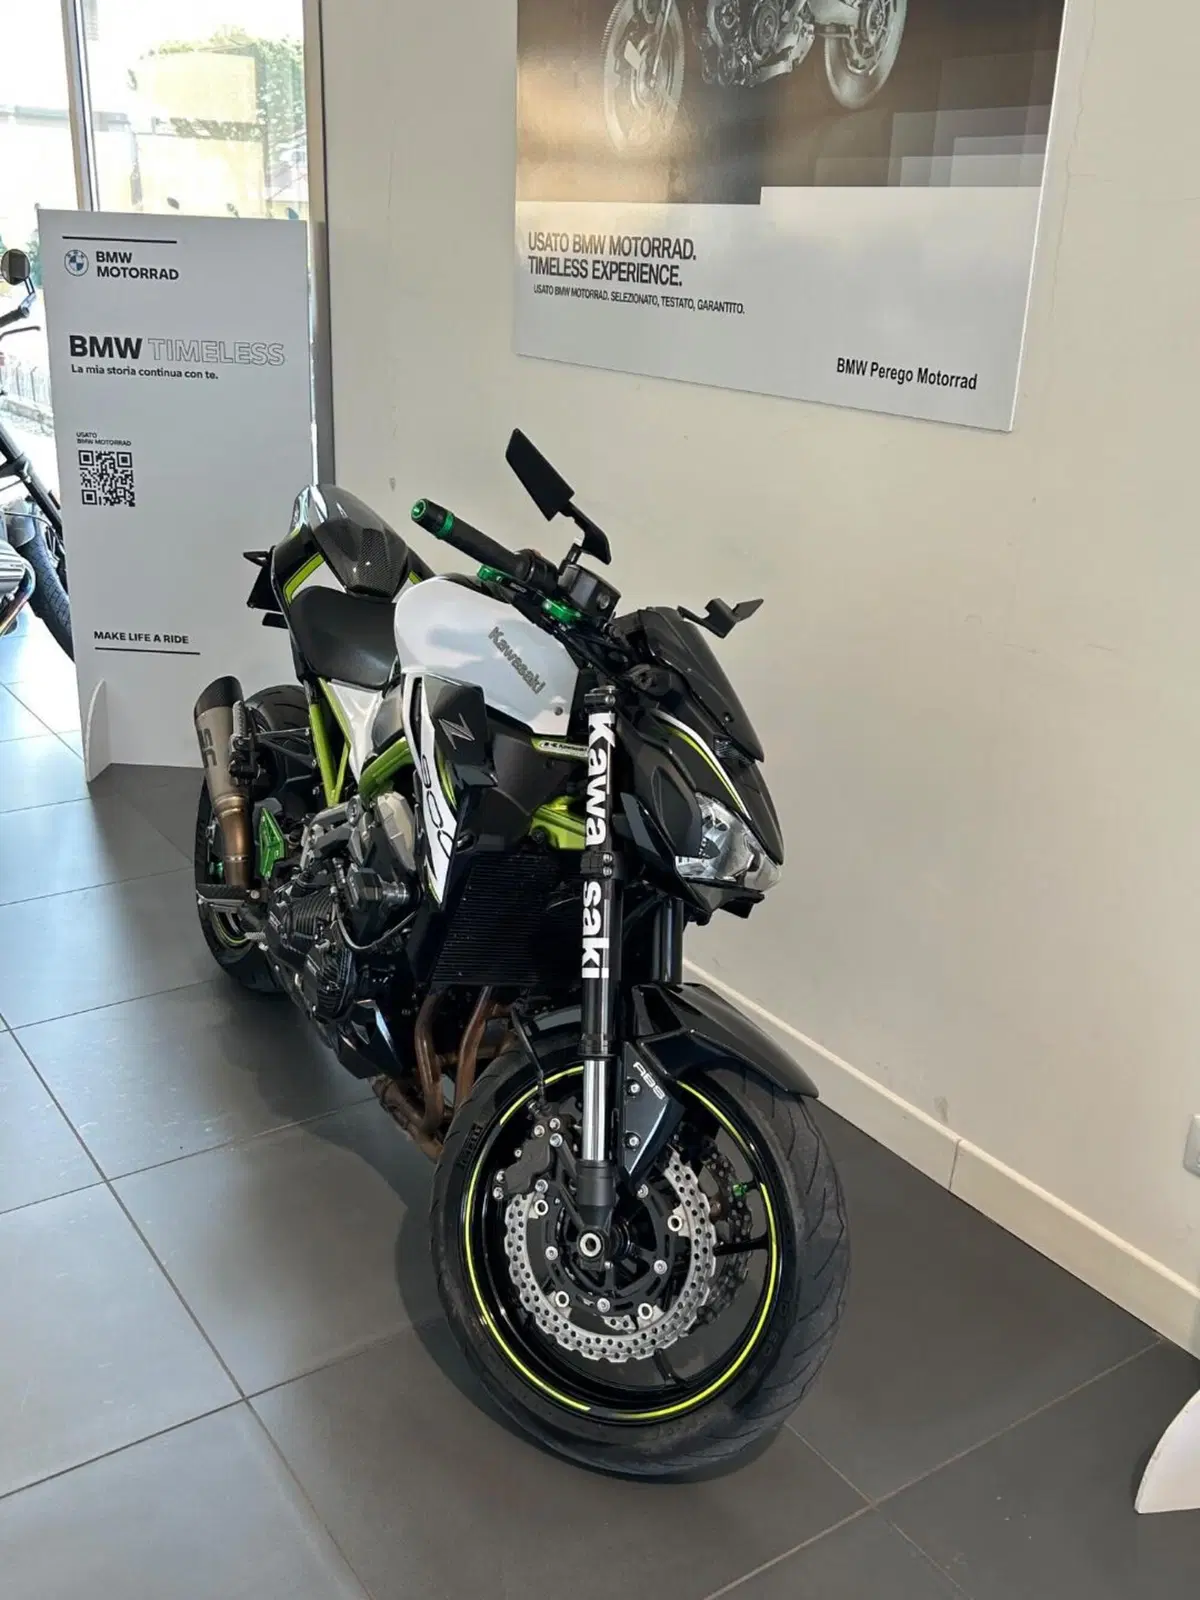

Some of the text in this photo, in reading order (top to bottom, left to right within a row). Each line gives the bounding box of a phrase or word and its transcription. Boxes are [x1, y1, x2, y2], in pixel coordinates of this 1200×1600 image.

[96, 251, 132, 264] BMW
[529, 232, 696, 260] USATO BMW MOTORRAD.
[96, 266, 179, 281] MOTORRAD
[528, 256, 682, 286] TIMELESS EXPERIENCE.
[534, 284, 553, 295] USATO
[554, 286, 570, 296] BMW
[610, 291, 660, 307] SELEZIONATO,
[661, 296, 696, 311] TESTATO,
[697, 299, 745, 314] GARANTITO.
[69, 335, 285, 367] BMW TIMELESS
[71, 365, 219, 380] La mia storia continua con te.
[837, 357, 978, 390] BMW Perego Motorrad
[94, 631, 189, 644] MAKE LIFE A RIDE
[488, 626, 546, 694] Kawasaki
